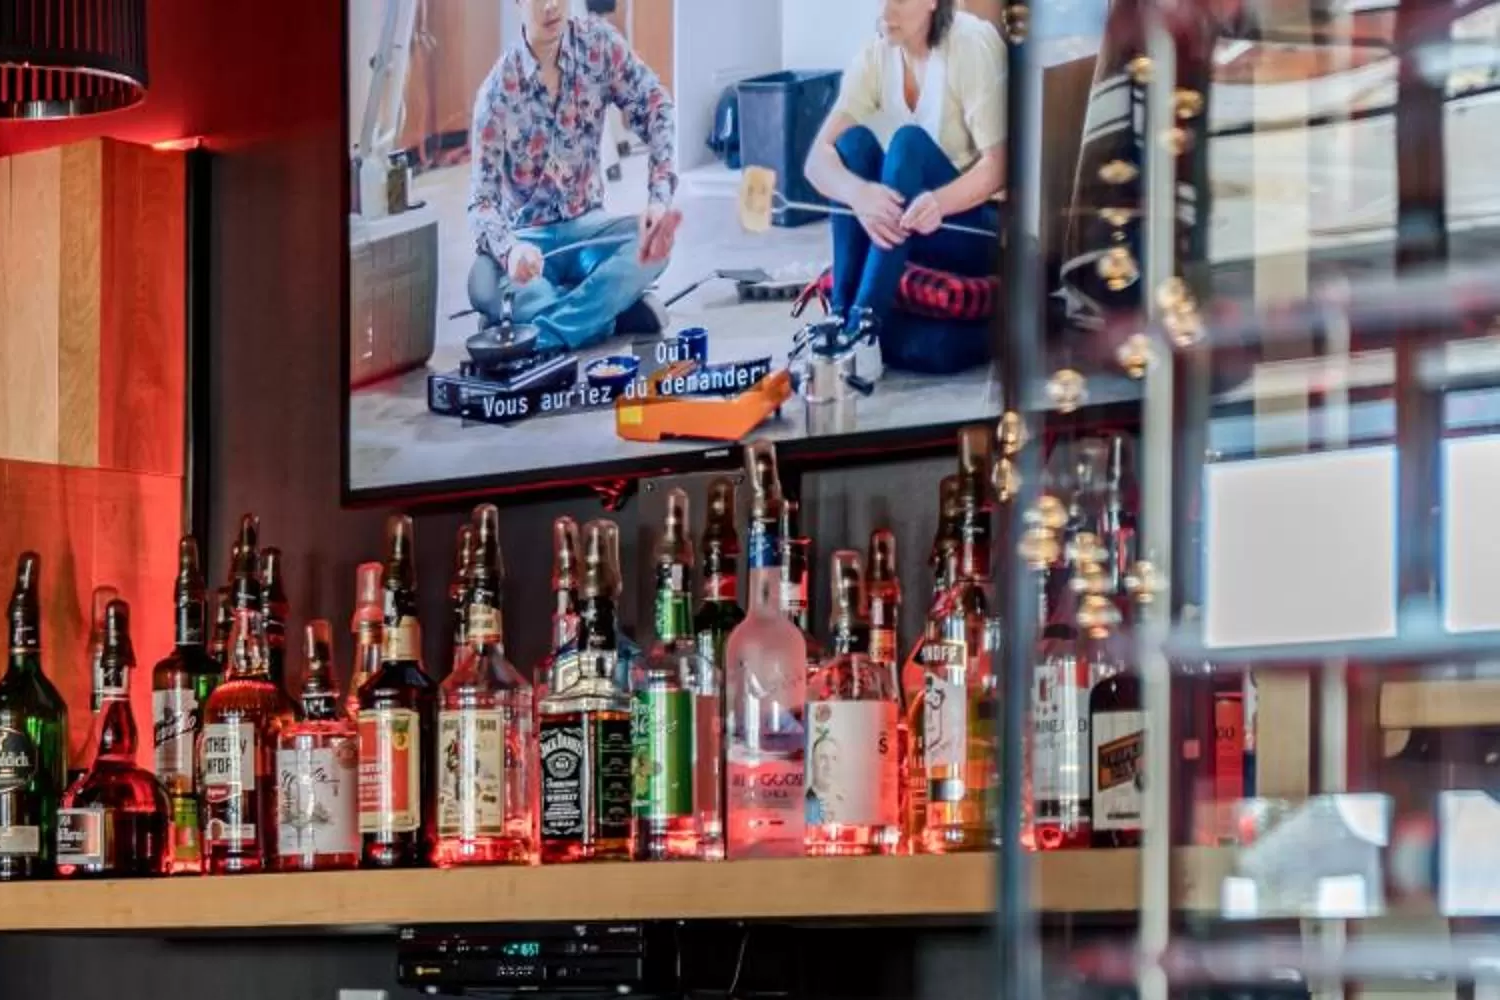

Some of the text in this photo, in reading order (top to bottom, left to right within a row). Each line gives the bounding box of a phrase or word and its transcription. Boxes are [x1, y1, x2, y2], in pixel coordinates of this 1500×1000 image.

[482, 395, 529, 418] Vous
[541, 383, 613, 411] auriez
[624, 376, 648, 399] dû
